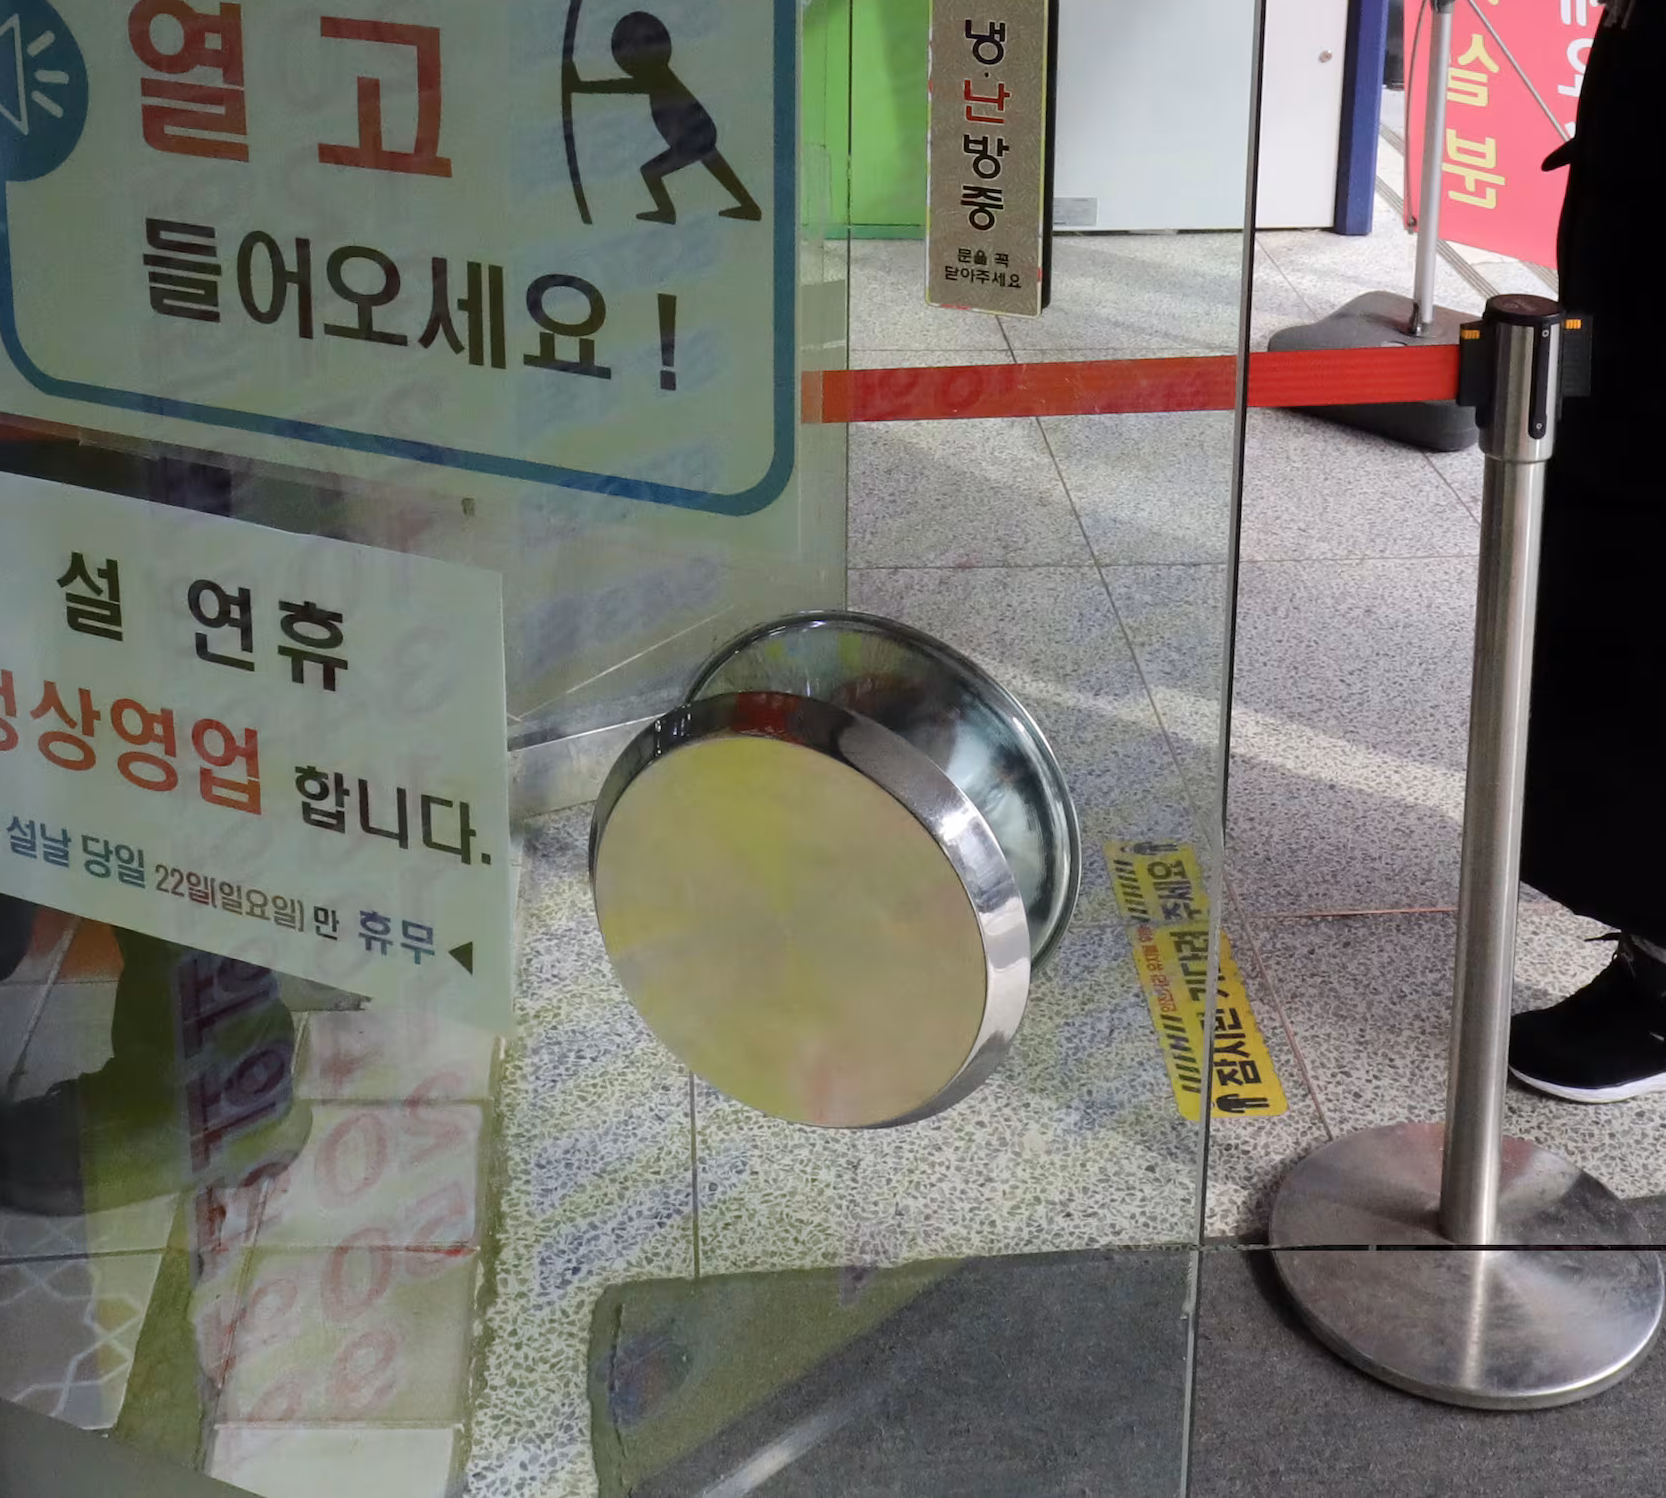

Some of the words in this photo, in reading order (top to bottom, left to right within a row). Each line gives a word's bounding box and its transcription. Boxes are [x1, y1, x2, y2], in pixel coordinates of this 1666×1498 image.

[944, 264, 1022, 290] 닫아주세요
[957, 247, 988, 267] 문을
[993, 250, 1010, 269] 꼭
[56, 550, 124, 642] 설
[186, 578, 349, 693] 연휴
[293, 764, 492, 866] 합니다.
[5, 813, 72, 870] 설날
[81, 832, 147, 891] 당일
[312, 906, 339, 943] 만
[357, 908, 436, 966] 휴무
[1146, 860, 1203, 922] 주세요
